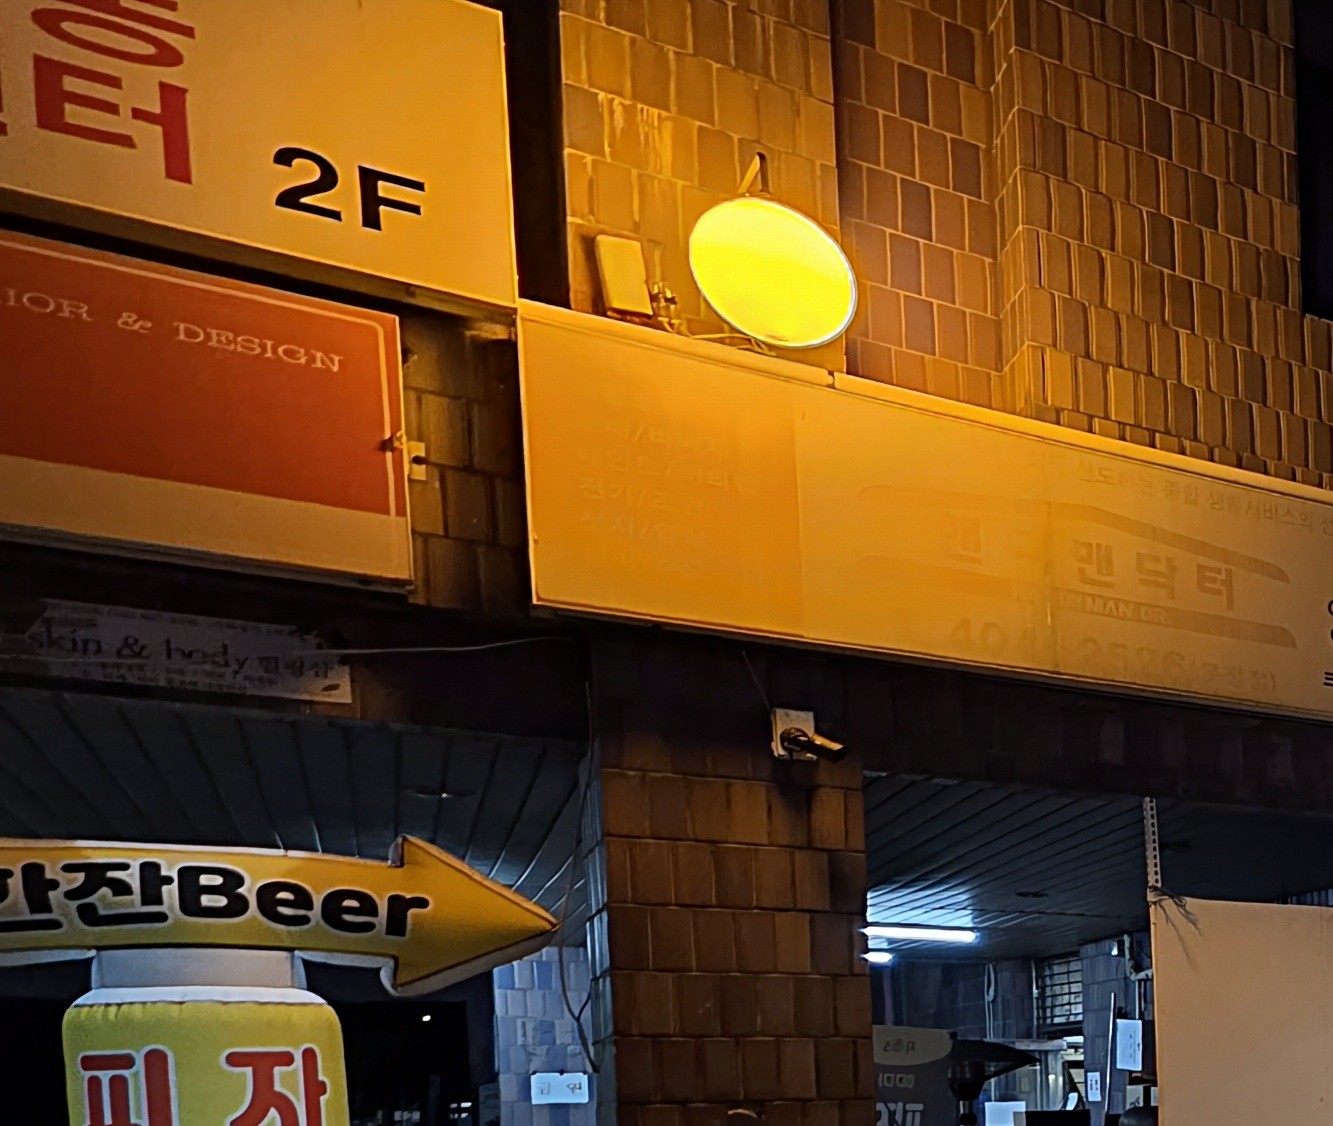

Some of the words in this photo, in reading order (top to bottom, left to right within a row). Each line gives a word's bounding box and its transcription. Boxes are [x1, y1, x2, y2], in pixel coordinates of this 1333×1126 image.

[273, 147, 425, 231] 2F
[0, 288, 93, 322] IOR
[116, 311, 153, 334] &
[172, 321, 344, 374] DESIGN
